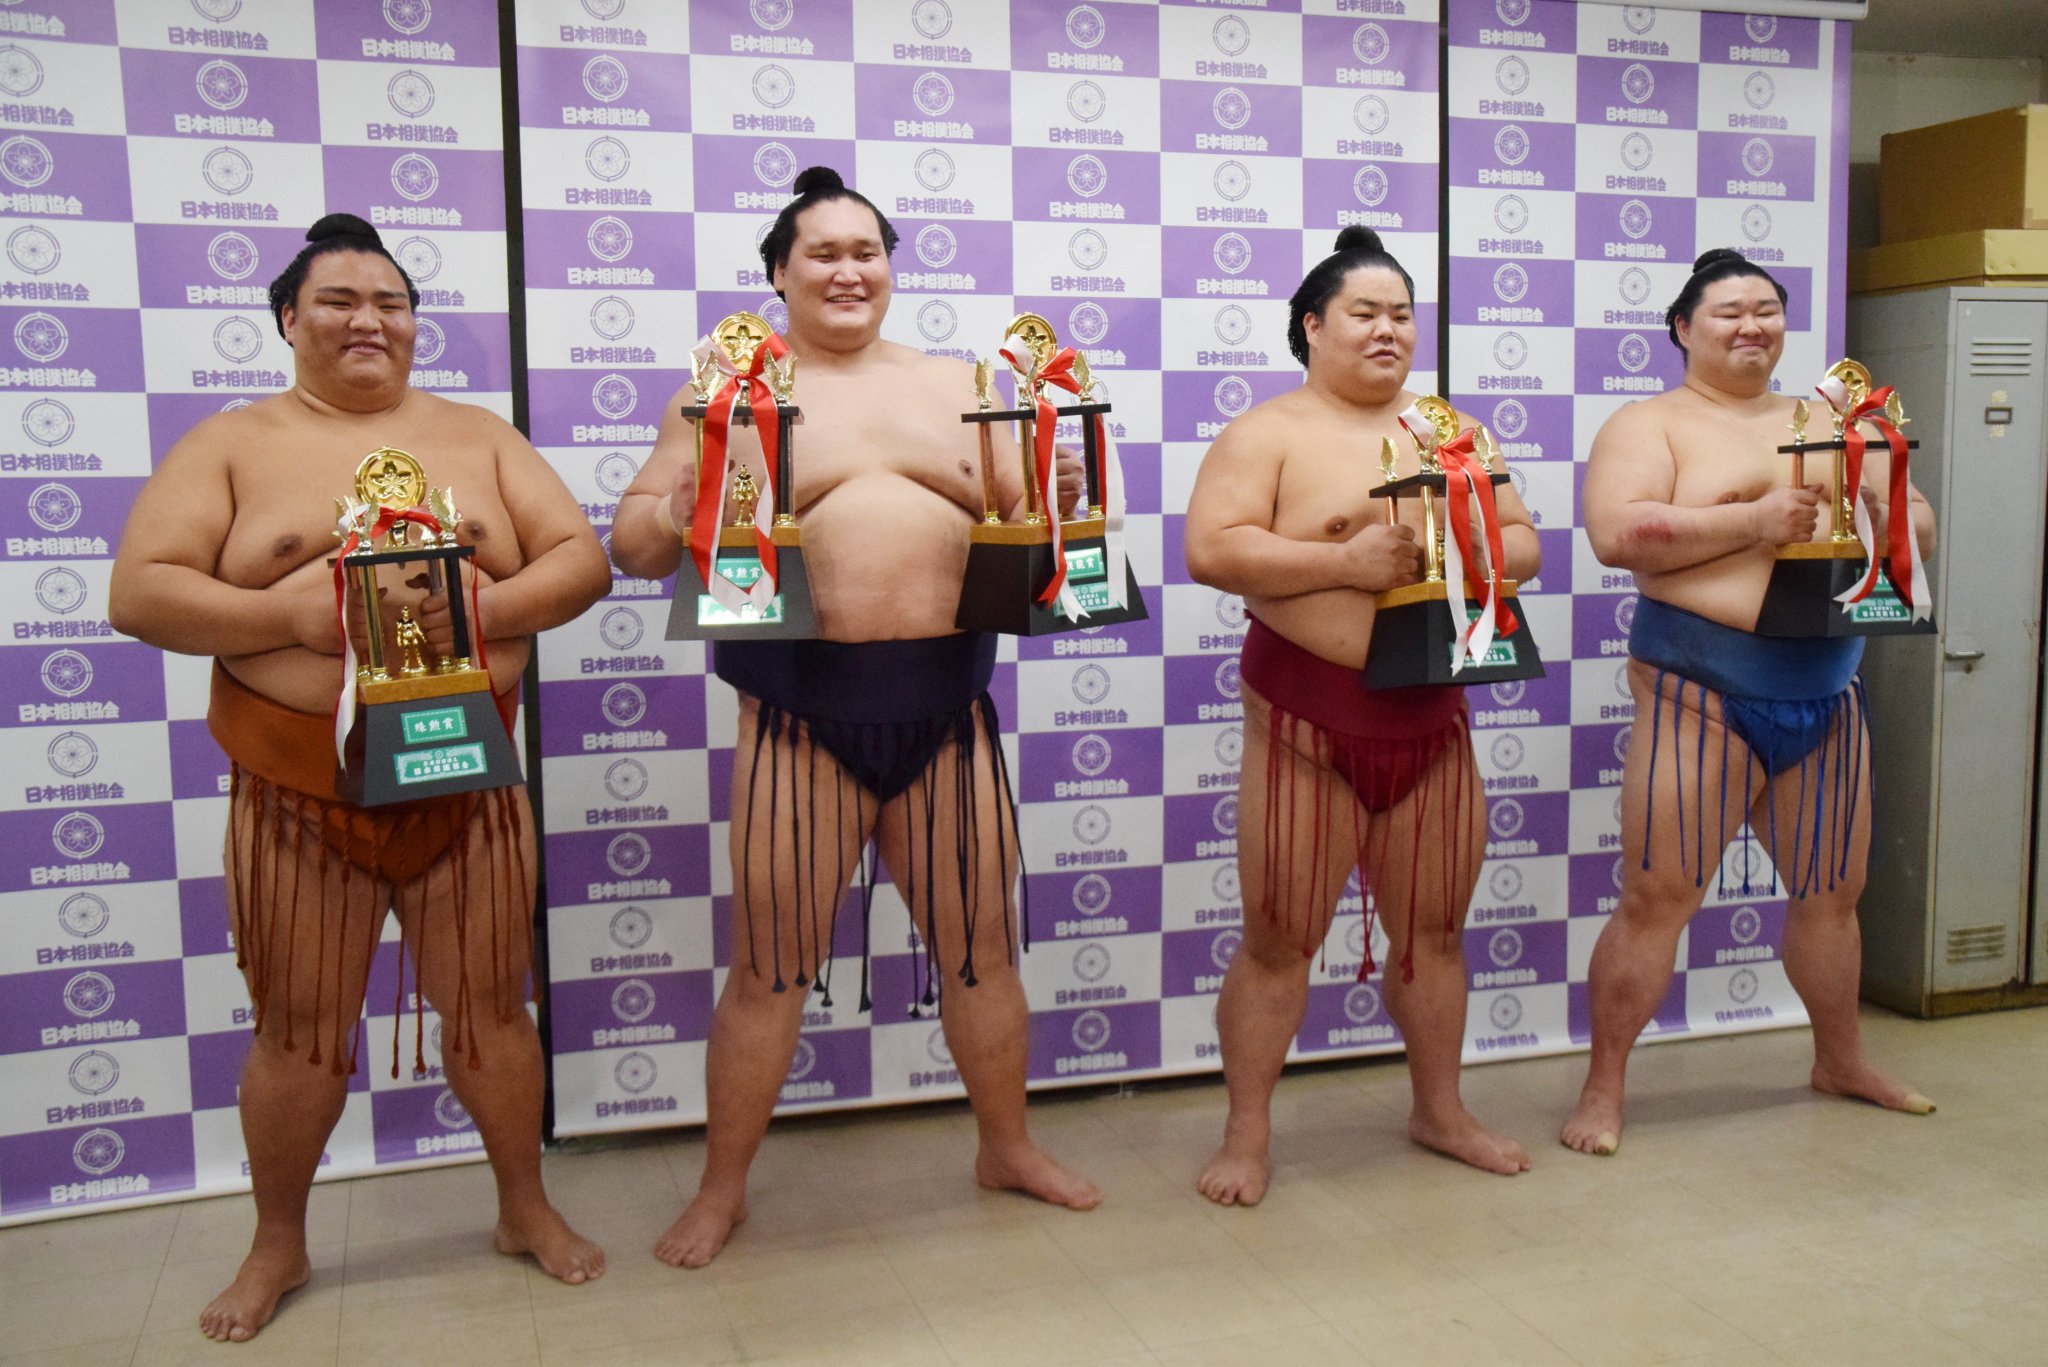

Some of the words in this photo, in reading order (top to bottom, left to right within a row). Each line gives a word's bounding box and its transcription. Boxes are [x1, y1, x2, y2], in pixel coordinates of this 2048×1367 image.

[167, 26, 268, 50] 日本相撲協会
[559, 24, 646, 46] 日本相撲協会
[730, 33, 813, 55] 日本相撲協会
[1479, 27, 1545, 48] 日本相撲協会
[361, 36, 455, 61] 日本相撲協会
[893, 43, 971, 63] 日本相撲協会
[1607, 37, 1669, 56] 日本相撲協会
[1729, 44, 1790, 64] 日本相撲協会
[1047, 51, 1123, 71] 日本相撲協会
[1195, 60, 1267, 78] 日本相撲協会
[1335, 67, 1404, 86] 日本相撲協会
[0, 104, 74, 126] 相撲協会
[562, 105, 650, 127] 日本相撲協会
[1479, 98, 1544, 117] 日本相撲協会
[1606, 106, 1668, 124] 日本相撲協会
[174, 113, 274, 136] 日本相撲協会
[732, 113, 815, 132] 日本相撲協会
[894, 119, 973, 139] 日本相撲協会
[1728, 113, 1787, 130] 日本相撲協会
[366, 122, 458, 143] 日本相撲協会
[1049, 126, 1123, 145] 日本相撲協会
[1195, 132, 1267, 151] 日本相撲協会
[1337, 139, 1403, 156] 日本相撲協会
[1478, 168, 1544, 186] 日本相撲協会
[1605, 174, 1666, 191] 日本相撲協会
[565, 186, 651, 206] 日本相撲協会
[1726, 179, 1786, 196] 日本相撲協会
[0, 192, 82, 213] 本相撲協会
[733, 191, 793, 209] 日本相撲
[895, 196, 973, 214] 日本相撲協会
[180, 200, 278, 221] 日本相撲協会
[370, 205, 461, 226] 日本相撲協会
[1049, 201, 1124, 219] 日本相撲協会
[1196, 206, 1267, 223] 日本相撲協会
[1337, 209, 1402, 226] 日本相撲協会
[1478, 237, 1543, 254] 日本相撲協会
[1604, 241, 1665, 258] 日本相撲協会
[567, 266, 654, 285] 日本相撲協会
[896, 272, 975, 289] 日本相撲協会
[1050, 275, 1125, 292] 日本相撲協会
[1, 281, 89, 301] 本相撲協会
[185, 285, 271, 305] 日本相撲協
[1196, 278, 1268, 295] 日本相撲協会
[419, 290, 465, 309] 撲協会
[1477, 306, 1543, 322] 日本相撲協会
[1603, 309, 1665, 325] 日本相撲協会
[570, 346, 655, 363] 日本相撲協会
[1197, 350, 1268, 365] 日本相撲協会
[191, 370, 287, 388] 日本相撲協会
[409, 371, 469, 389] 相撲協会
[1478, 375, 1542, 389] 日本相撲協会
[1603, 376, 1664, 391] 日本相撲協会
[572, 424, 658, 441] 日本相撲協会
[0, 453, 102, 471] 日本相撲協会
[5, 535, 109, 556] 日本相撲協会
[1601, 574, 1632, 588] 日本相
[12, 618, 114, 640] 日本相撲協会
[1053, 637, 1127, 655] 日本相撲協会
[1198, 633, 1244, 649] 日本相撲
[580, 655, 664, 673] 日本相撲協会
[18, 700, 119, 722] 日本相撲協会
[1054, 708, 1127, 726] 日本相撲協会
[1198, 702, 1243, 719] 日本相撲
[1475, 708, 1539, 726] 日本相撲協会
[1600, 703, 1634, 719] 日本相
[582, 729, 667, 750] 日本相撲協会
[1054, 777, 1128, 797] 日本相撲協会
[1484, 773, 1538, 791] 本相撲協会
[25, 781, 124, 803] 日本相撲協会
[585, 804, 668, 824] 日本相撲協会
[1484, 838, 1538, 856] 本相撲協会
[1055, 848, 1127, 866] 日本相撲協会
[30, 860, 130, 885] 日本相撲協会
[587, 877, 671, 899] 日本相撲協会
[1195, 906, 1241, 924] 日本相撲
[36, 940, 134, 964] 日本相撲協会
[40, 1017, 140, 1045] 日本相撲協会
[46, 1096, 144, 1123] 日本相撲協会
